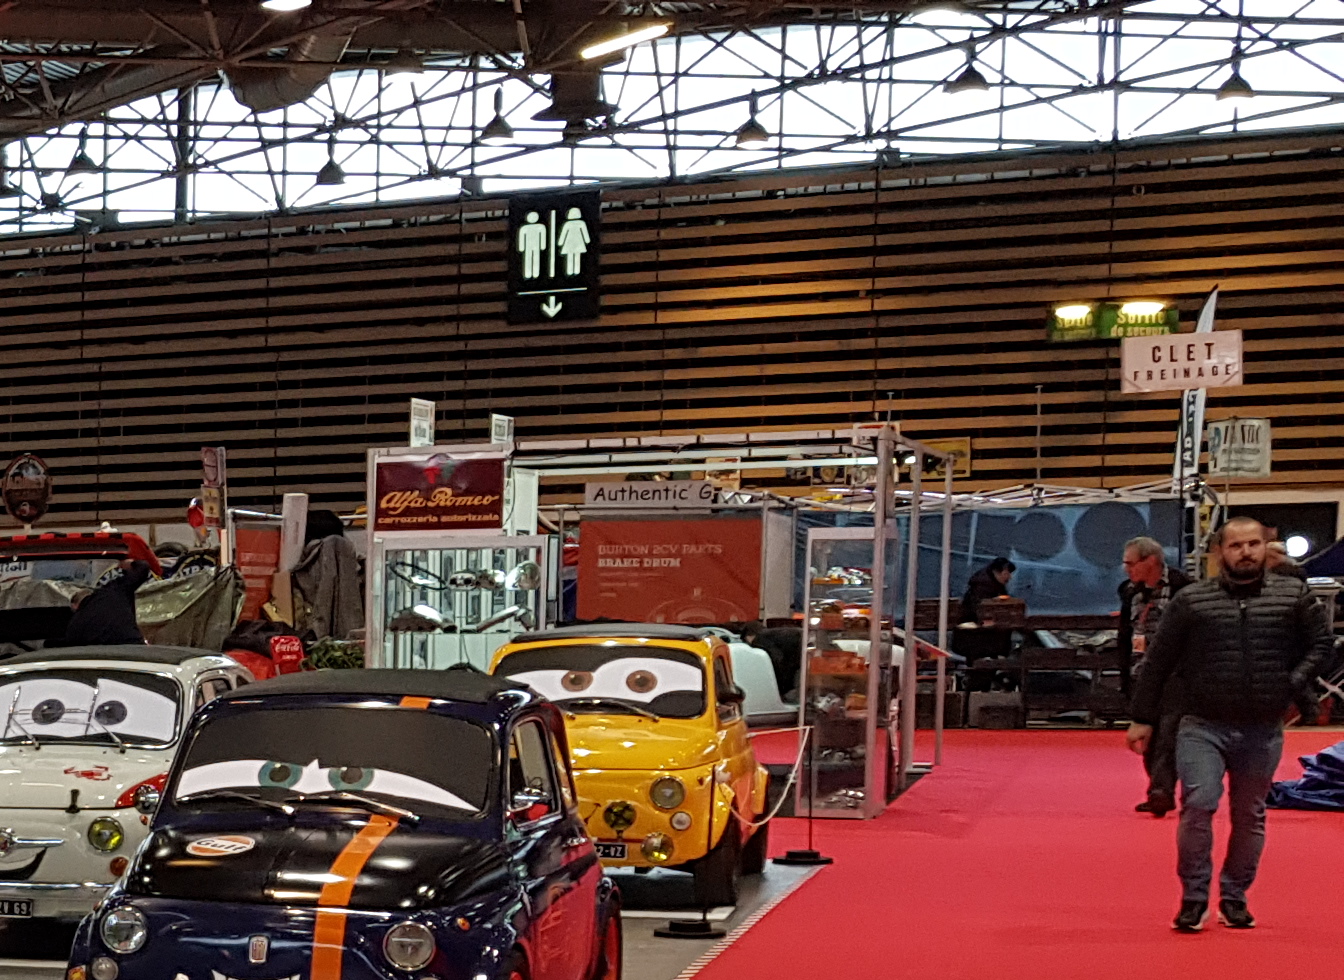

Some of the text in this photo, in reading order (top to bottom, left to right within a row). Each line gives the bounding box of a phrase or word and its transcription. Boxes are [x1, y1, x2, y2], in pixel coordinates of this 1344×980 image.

[1151, 343, 1215, 363] CLET
[1133, 364, 1232, 381] FREINAGE
[380, 487, 500, 515] Alfa Romeo
[197, 840, 247, 851] Gulf
[14, 902, 27, 915] 69
